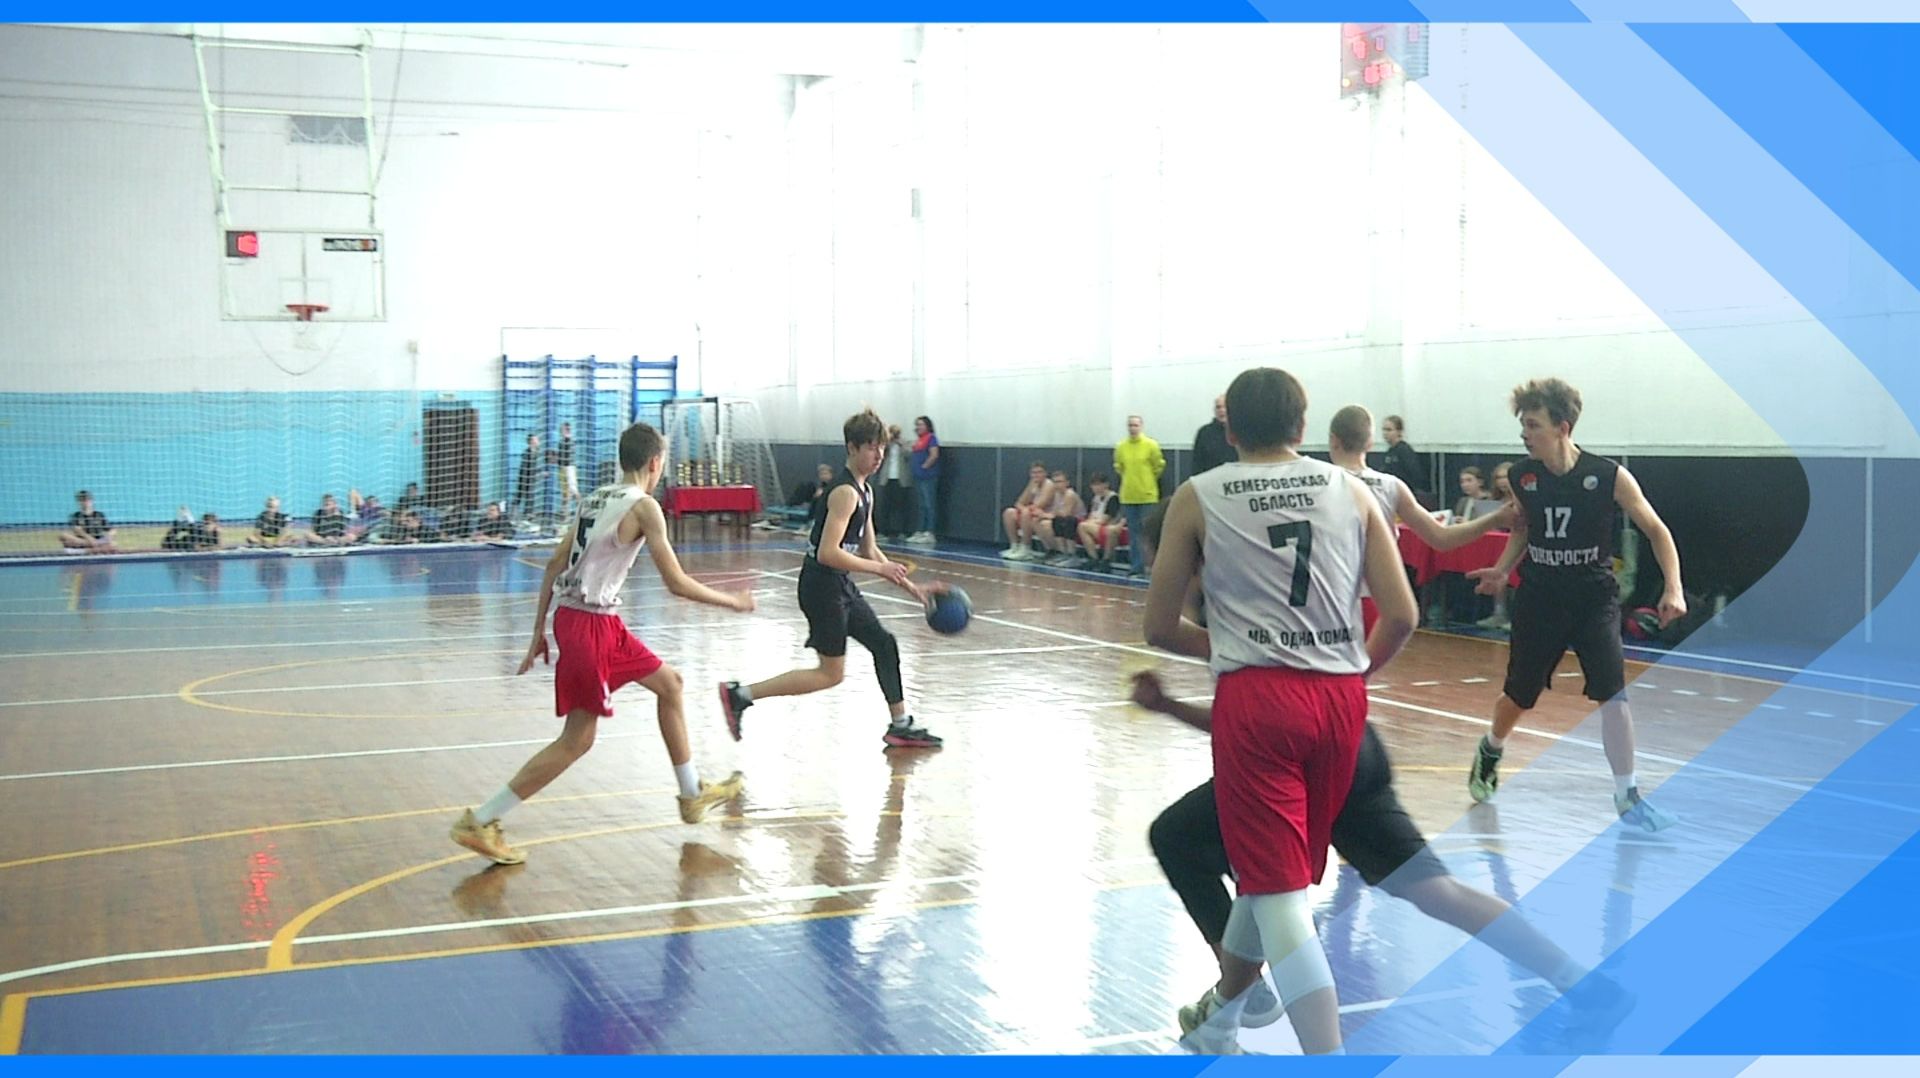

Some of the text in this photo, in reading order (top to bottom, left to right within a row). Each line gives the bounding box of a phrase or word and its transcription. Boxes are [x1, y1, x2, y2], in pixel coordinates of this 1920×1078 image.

[1223, 474, 1329, 496] КЕМЕРОВСКАЯ
[1249, 493, 1315, 513] ОБЛАСТЬ
[1544, 506, 1572, 538] 17
[1267, 520, 1312, 607] 7
[1248, 626, 1354, 649] МЫ ОДНА КОМА
